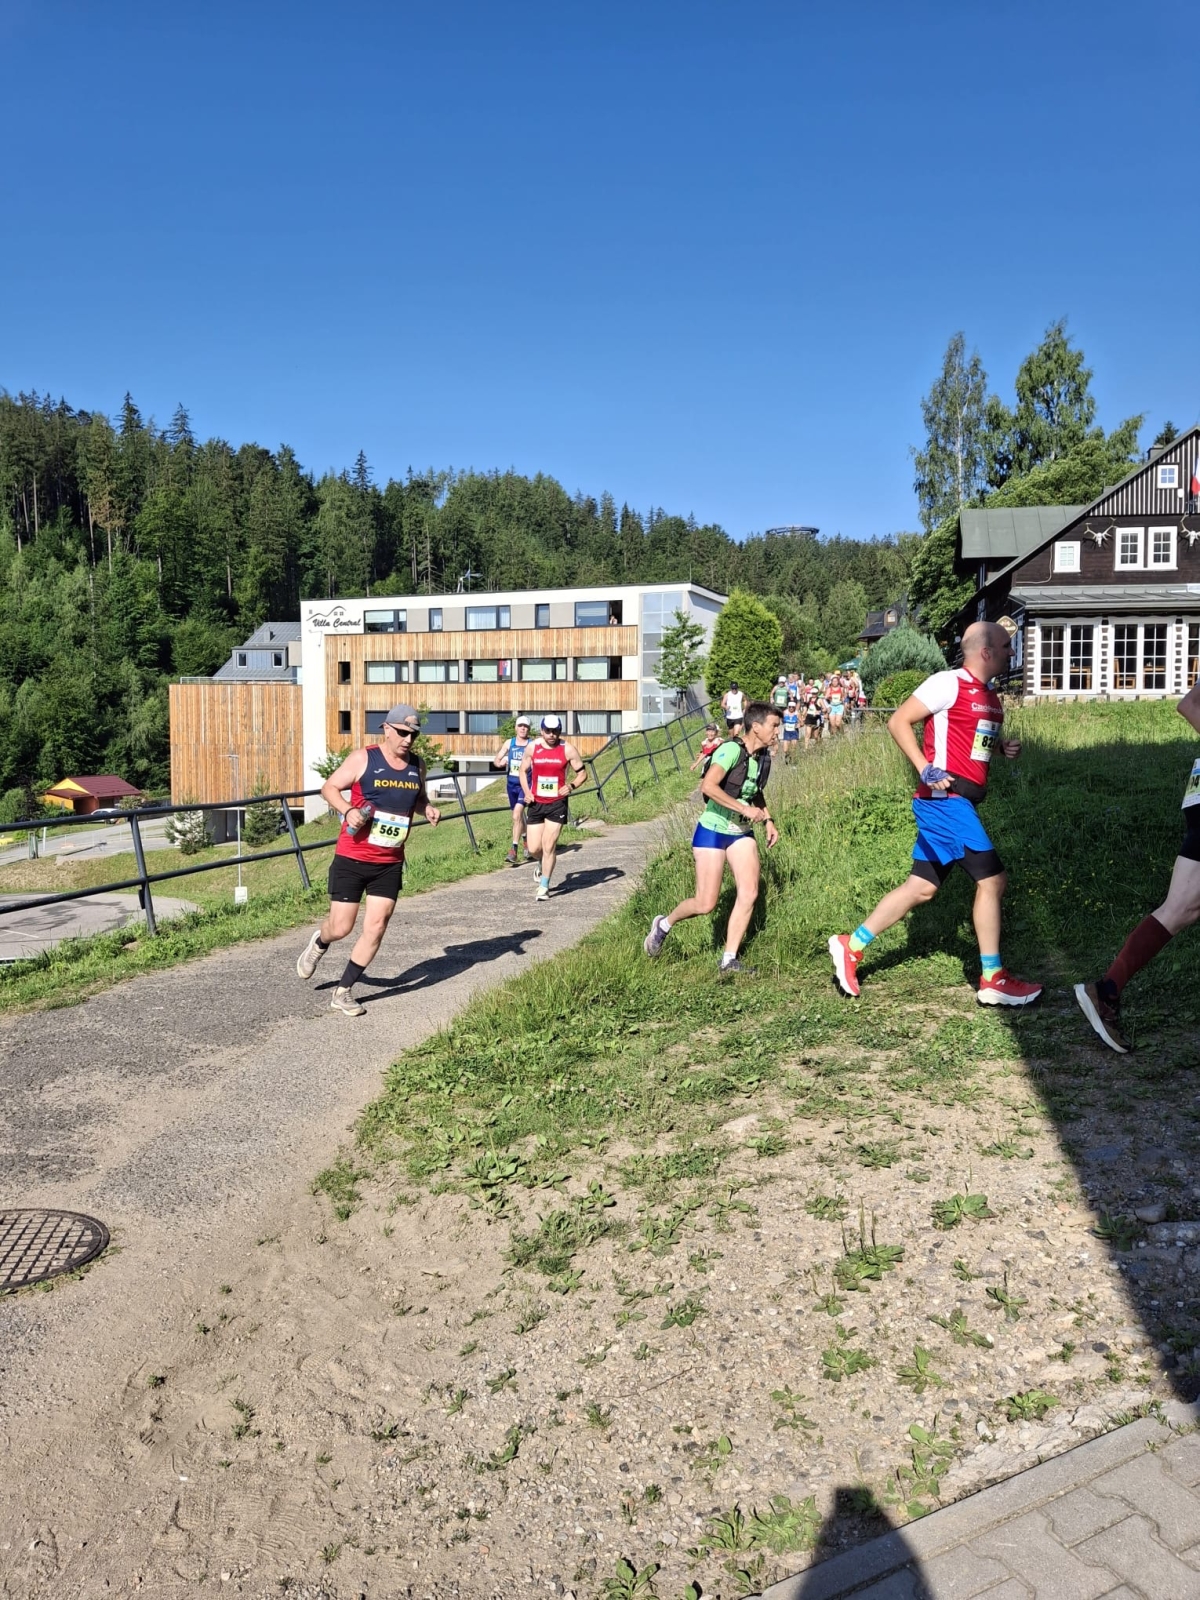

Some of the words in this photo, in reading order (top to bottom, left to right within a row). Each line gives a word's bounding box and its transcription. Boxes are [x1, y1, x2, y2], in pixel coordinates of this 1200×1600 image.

[312, 618, 330, 627] Villa
[333, 617, 361, 628] Central
[981, 735, 995, 748] 82
[512, 751, 524, 759] US
[374, 779, 420, 790] ROMANIA
[379, 824, 401, 837] 565
